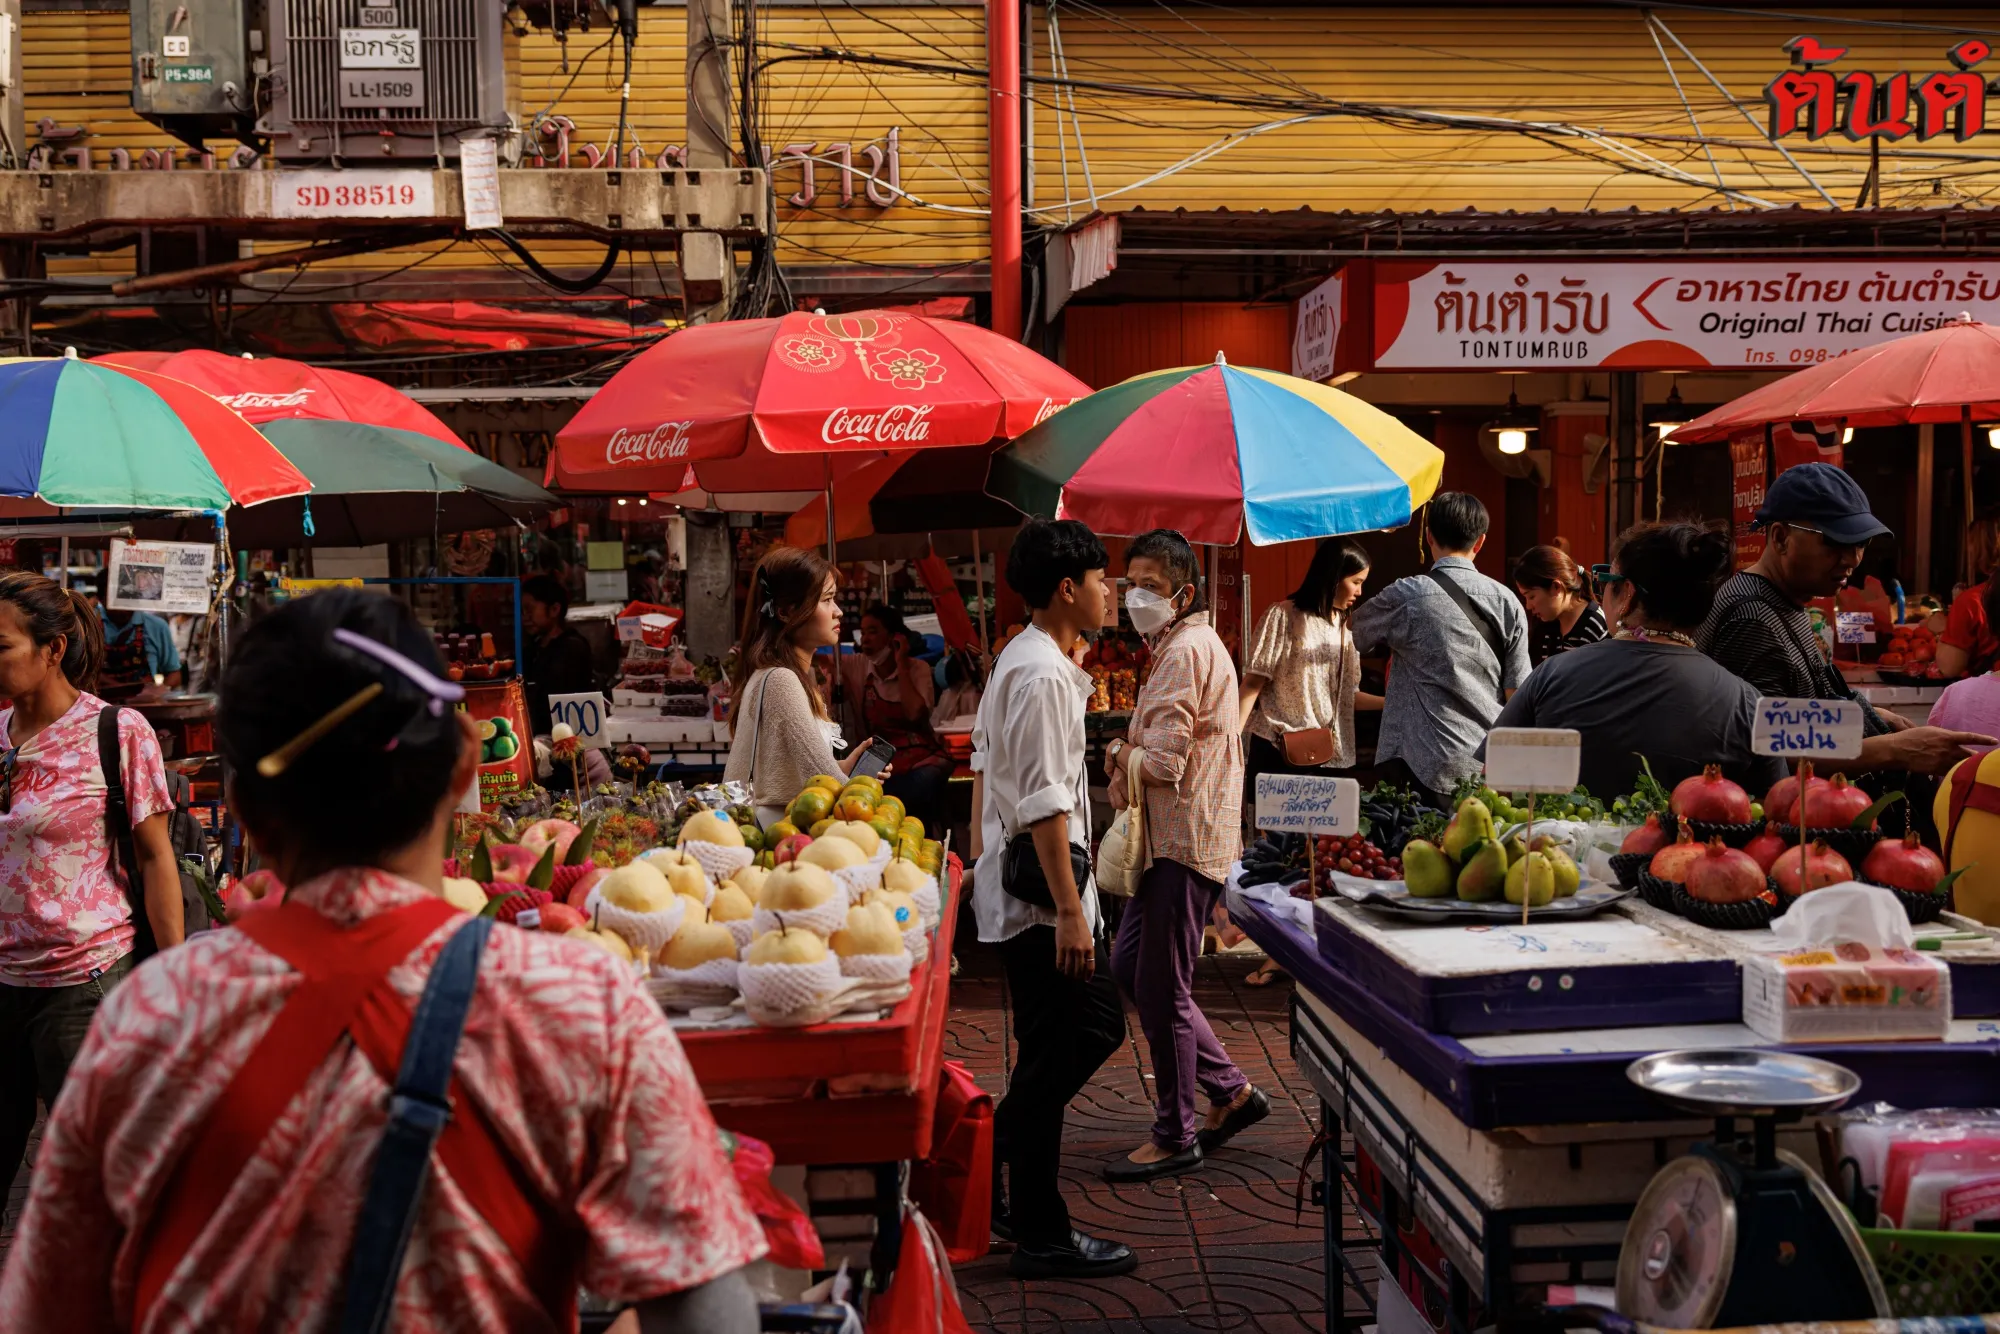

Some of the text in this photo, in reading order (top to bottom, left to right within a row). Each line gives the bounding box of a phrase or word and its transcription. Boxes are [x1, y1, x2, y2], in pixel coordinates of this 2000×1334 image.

[364, 11, 393, 25] 500
[344, 33, 415, 64] เอกรัฐ
[349, 82, 413, 97] LL-1509
[1676, 269, 2000, 302] อาหารไทย ต้นตำรับ
[1434, 271, 1610, 334] ต้นตำรับ
[1699, 312, 1807, 339] Original
[1817, 312, 1872, 333] Thai
[1460, 341, 1588, 359] TONTUMRUB
[216, 388, 316, 408] a-Cola
[822, 404, 935, 443] Coca-Cola
[606, 420, 695, 464] Coca-Cola
[550, 700, 600, 737] 100
[1764, 701, 1842, 726] ทับทิม
